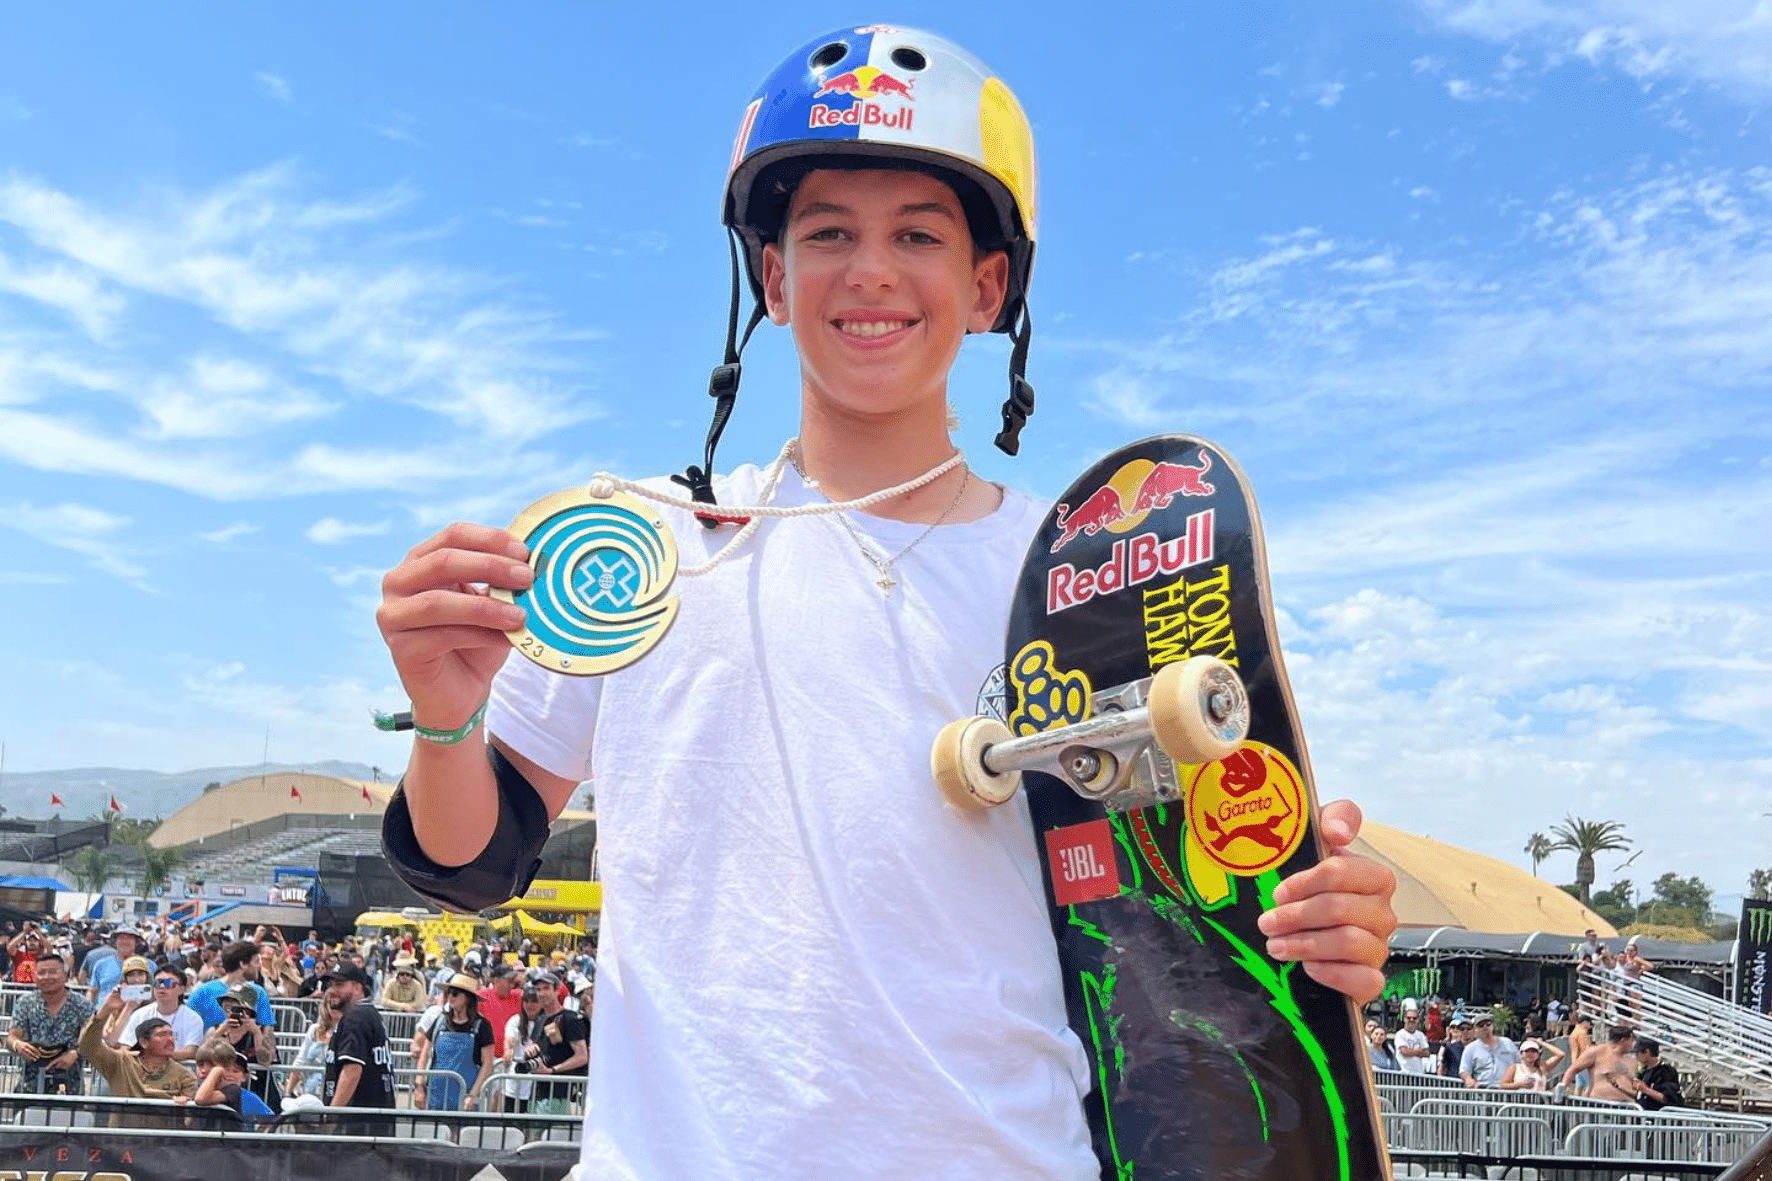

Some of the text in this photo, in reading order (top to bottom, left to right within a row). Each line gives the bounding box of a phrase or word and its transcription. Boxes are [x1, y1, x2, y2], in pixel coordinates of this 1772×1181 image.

[809, 100, 914, 131] Red Bull
[1047, 508, 1215, 615] Red Bull
[1143, 575, 1190, 676] HAW
[520, 636, 545, 658] 23
[1218, 795, 1273, 822] Garoto
[1059, 844, 1105, 882] JBL
